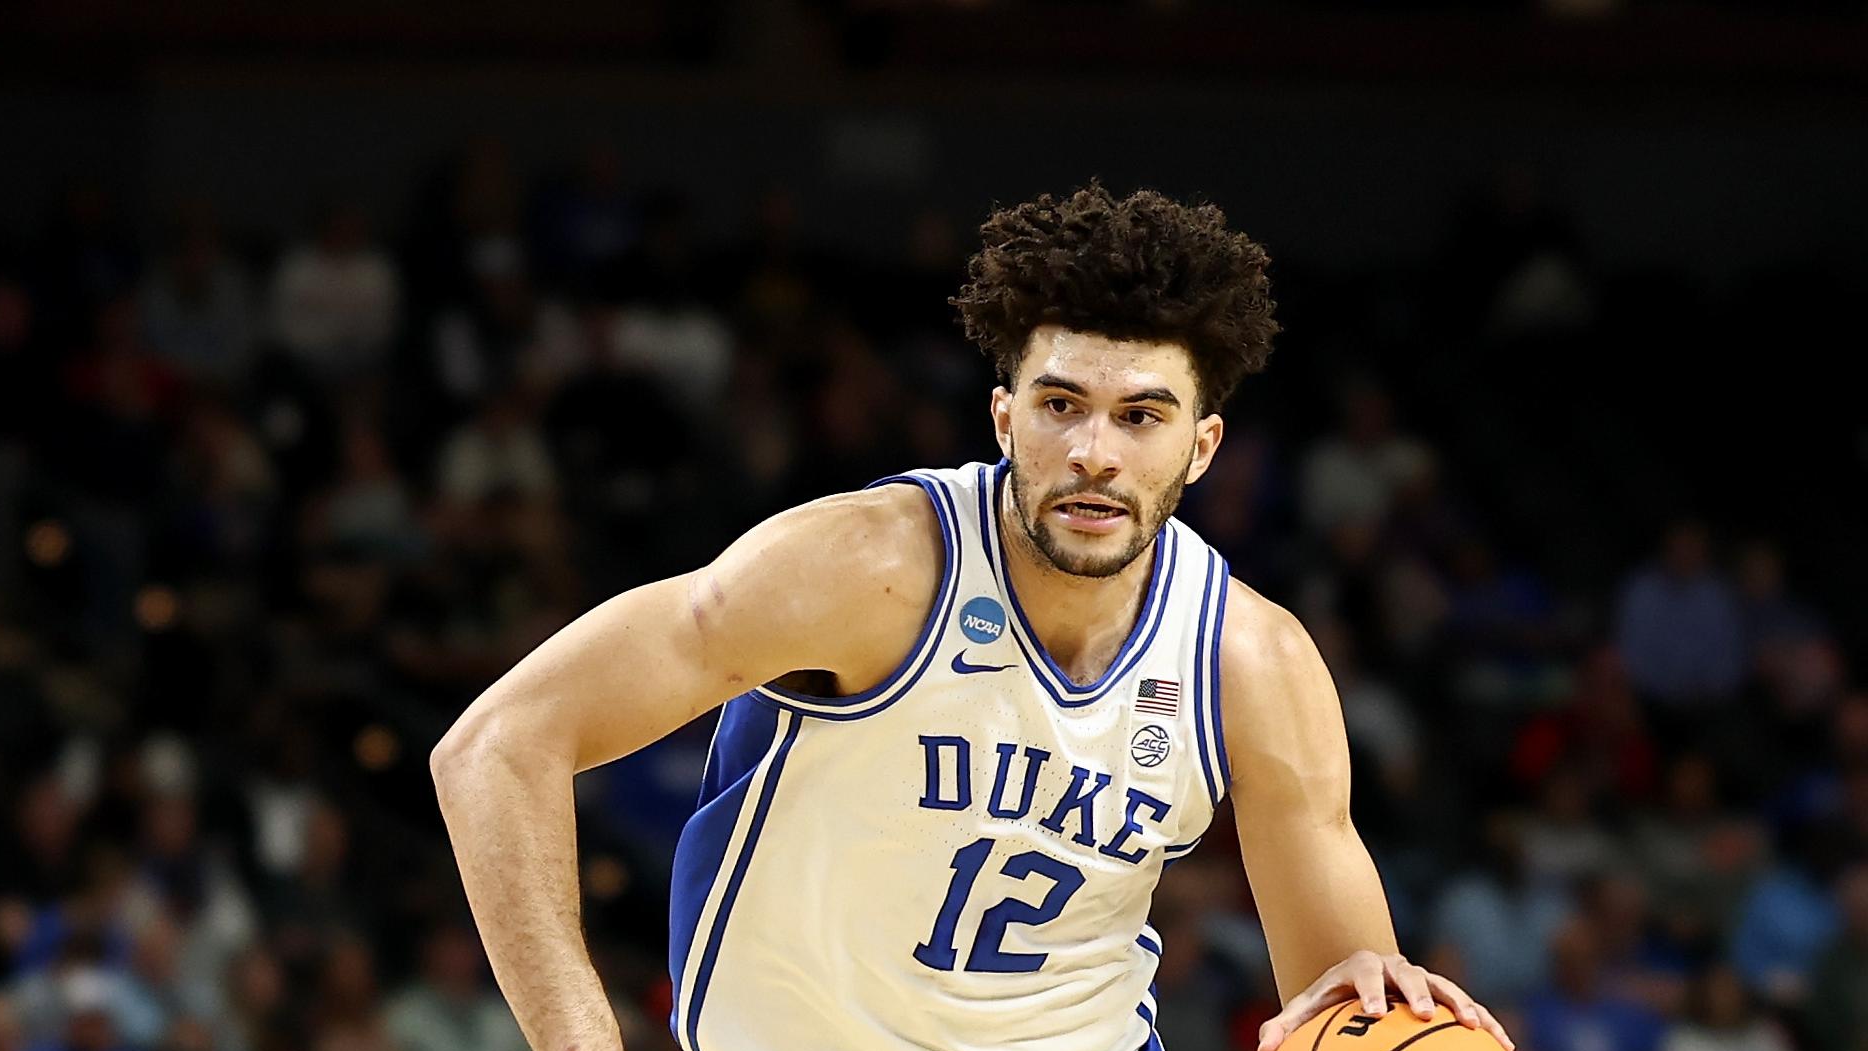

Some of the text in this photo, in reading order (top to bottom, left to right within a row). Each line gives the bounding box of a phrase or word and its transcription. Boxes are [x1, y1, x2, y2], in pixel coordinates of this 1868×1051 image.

[963, 614, 1001, 637] NCAA
[1136, 737, 1169, 751] ACC
[918, 734, 1172, 864] DUKE
[912, 838, 1086, 972] 12
